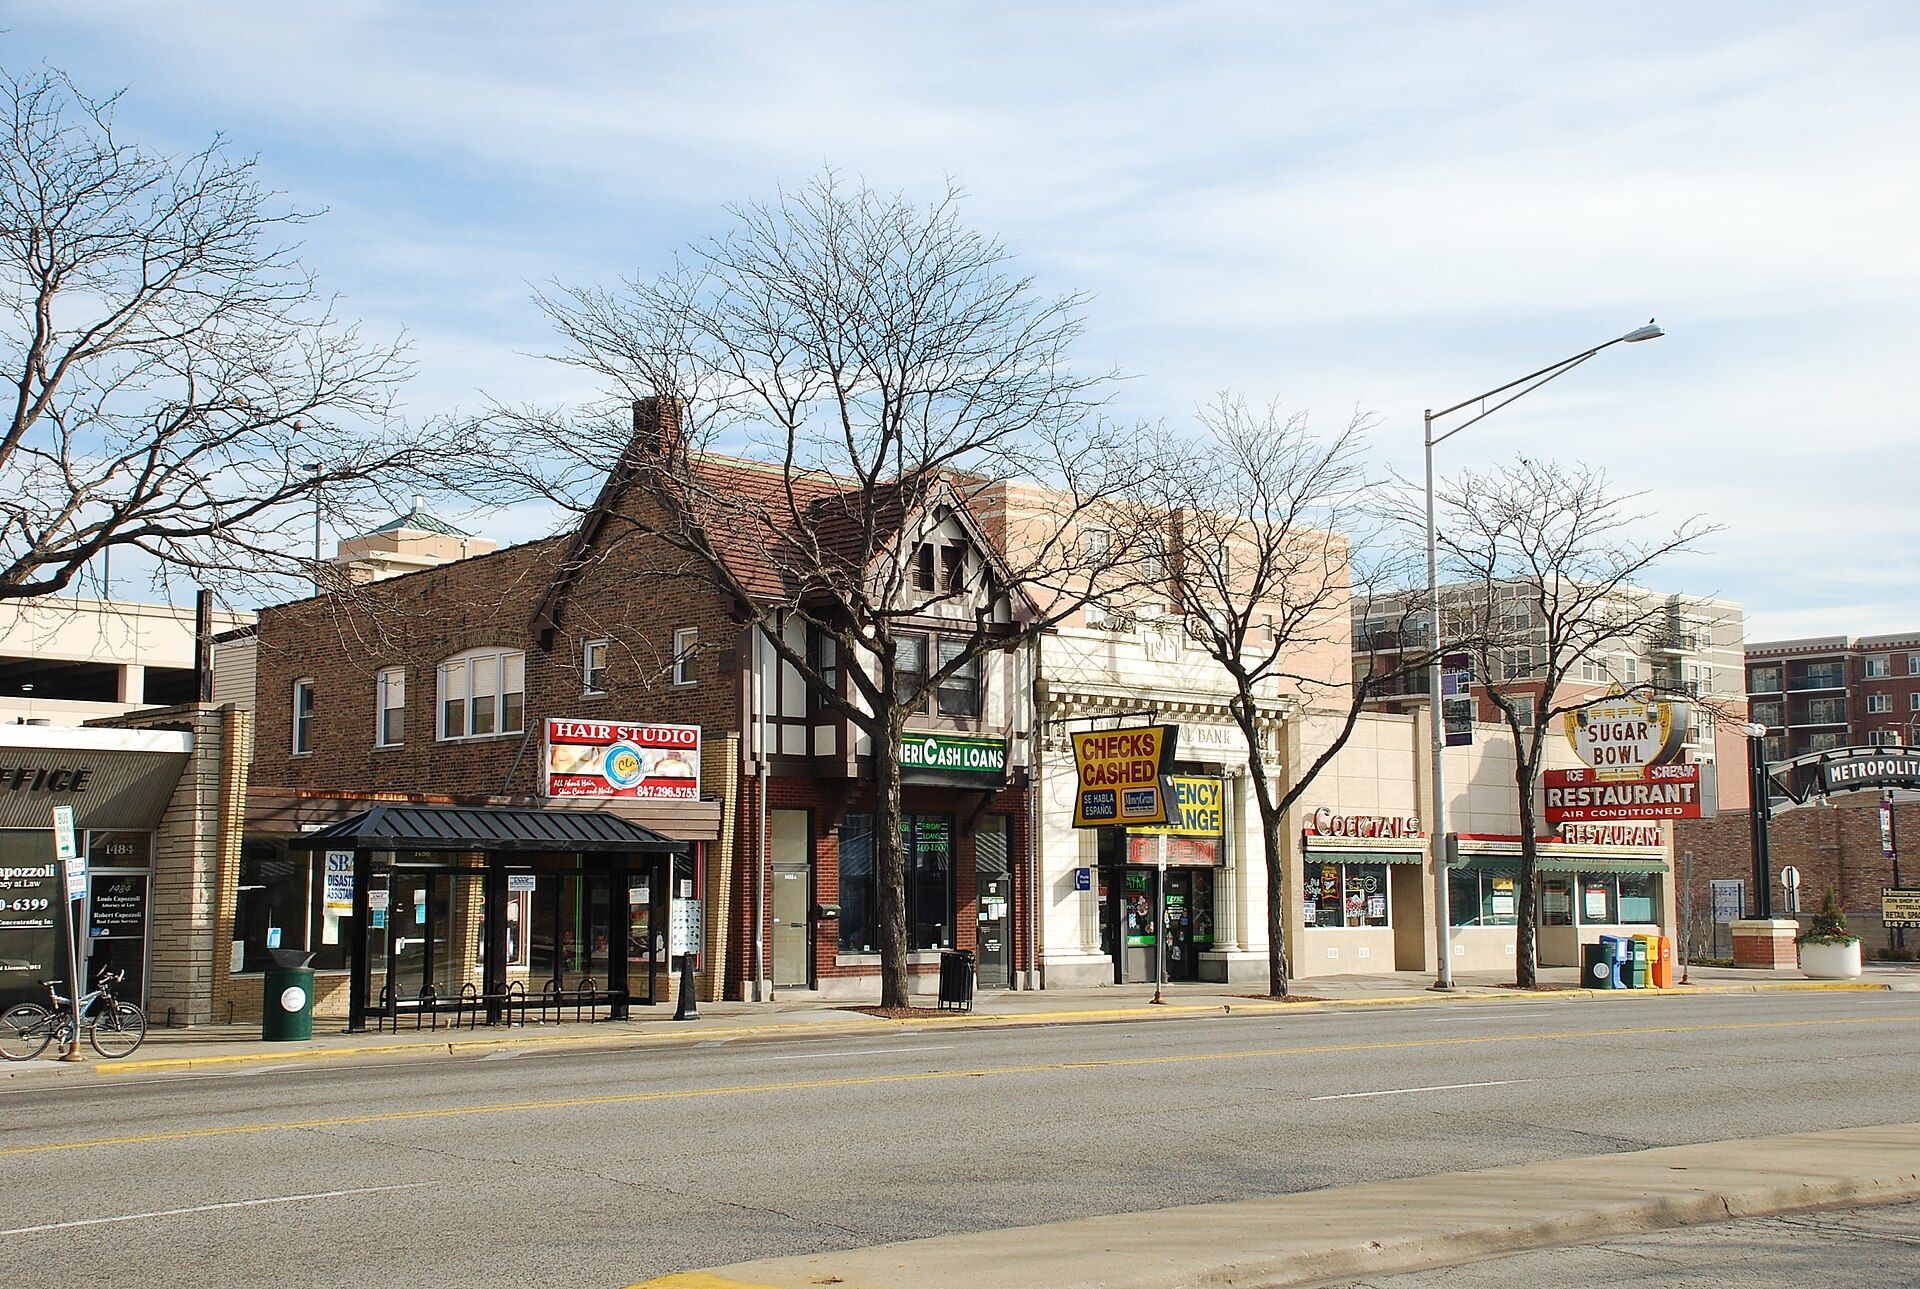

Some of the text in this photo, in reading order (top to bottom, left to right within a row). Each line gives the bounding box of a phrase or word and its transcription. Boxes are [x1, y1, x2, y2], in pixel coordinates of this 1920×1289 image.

[556, 723, 696, 744] HAIR STUDIO
[1198, 728, 1231, 746] BANK
[1588, 721, 1648, 743] SUGAR
[1082, 733, 1155, 761] CHECKS
[1593, 745, 1643, 765] BOWL
[964, 748, 1004, 768] LOANS
[1083, 760, 1156, 786] CASHED
[1566, 765, 1695, 782] ICE CREAM
[1830, 760, 1920, 782] METROPOLIT
[637, 785, 697, 799] 847.296.5753
[1083, 793, 1115, 804] SE HABLA
[1175, 783, 1219, 806] ENCY
[1547, 783, 1695, 807] RESTAURANT
[1085, 803, 1113, 815] ESPAÑOL
[1590, 807, 1683, 818] CONDITIONED
[1565, 824, 1664, 846] RESTAURANT
[105, 844, 134, 855] 1484
[1131, 839, 1216, 864] OPEN
[328, 854, 354, 871] SB
[23, 880, 41, 888] Law
